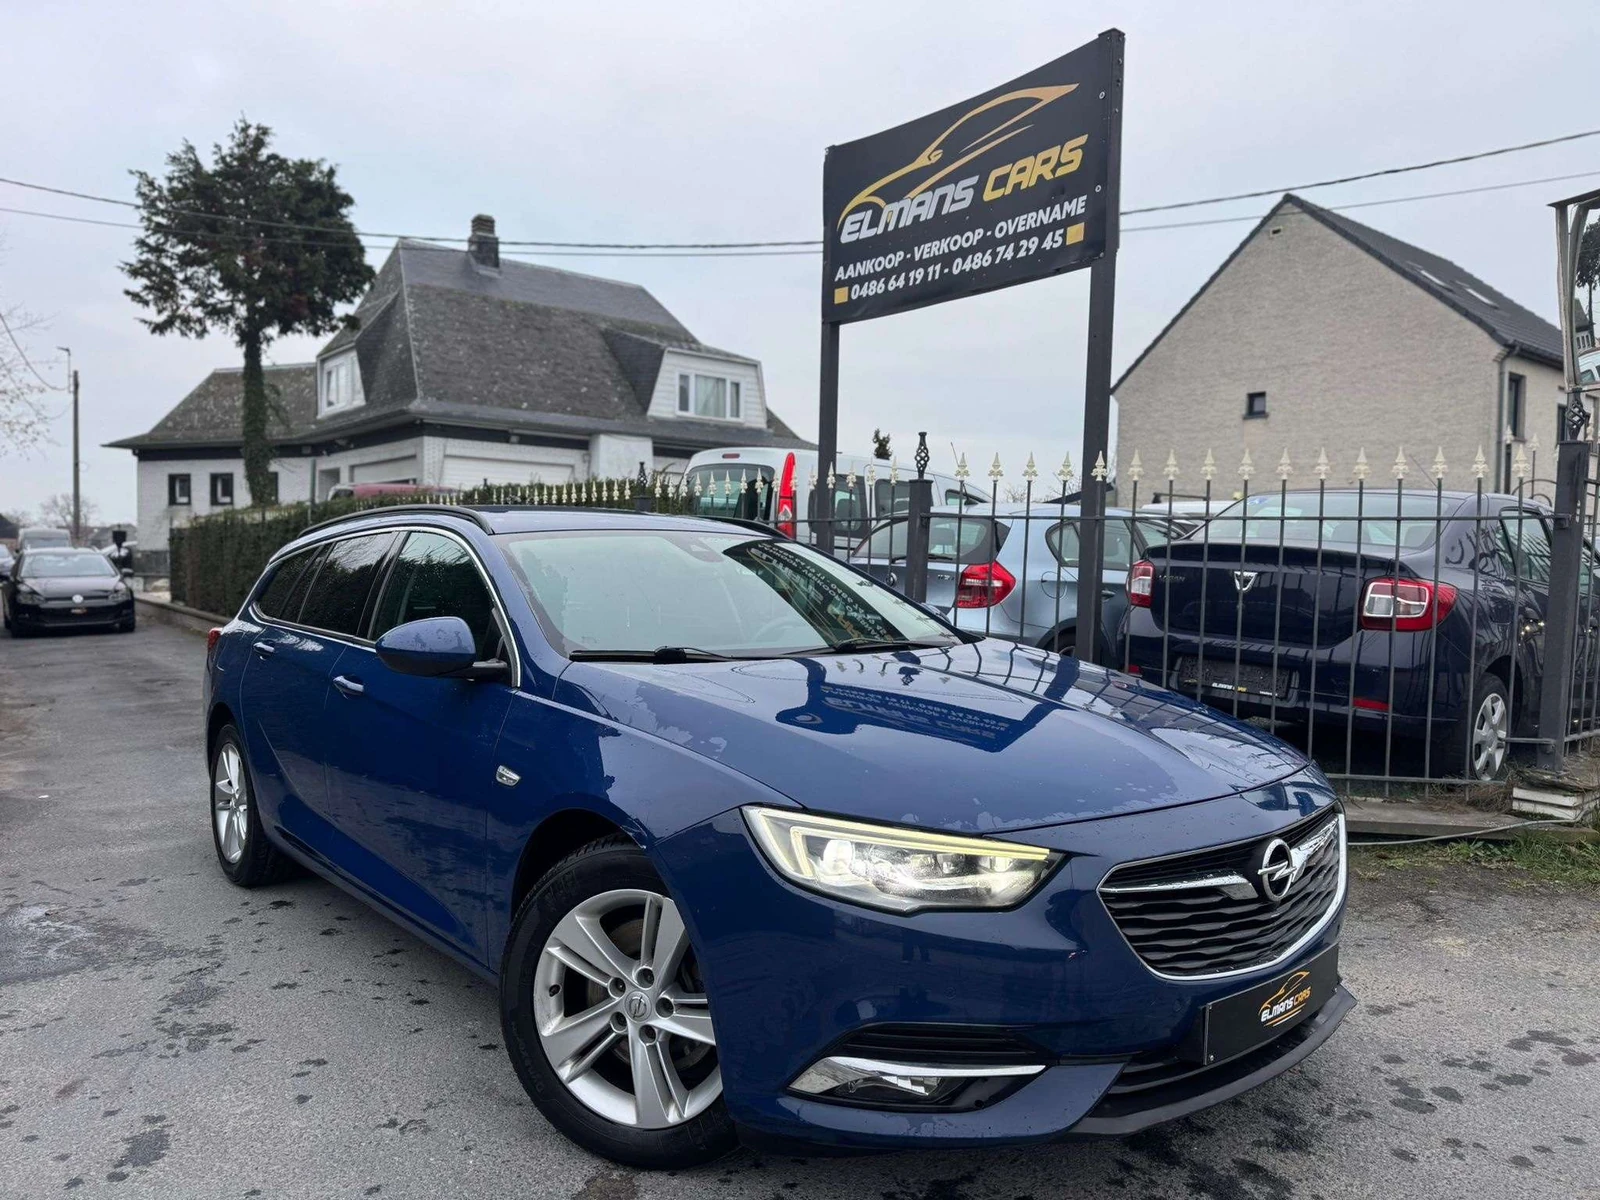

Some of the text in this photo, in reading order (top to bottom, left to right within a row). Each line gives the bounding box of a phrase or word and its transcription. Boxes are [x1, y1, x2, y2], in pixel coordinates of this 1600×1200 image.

[840, 134, 1088, 244] ELMANS CARS
[834, 252, 904, 282] AANKOOP
[913, 228, 984, 262] VERKOOP
[994, 195, 1087, 240] OVERNAME
[851, 281, 885, 300] 0486
[887, 276, 905, 292] 64
[908, 270, 924, 287] 19
[927, 265, 941, 282] 11
[952, 253, 992, 275] 0486
[995, 245, 1014, 263] 74
[1017, 239, 1036, 258] 29
[1041, 229, 1064, 251] 45
[1261, 997, 1294, 1021] ELMANS
